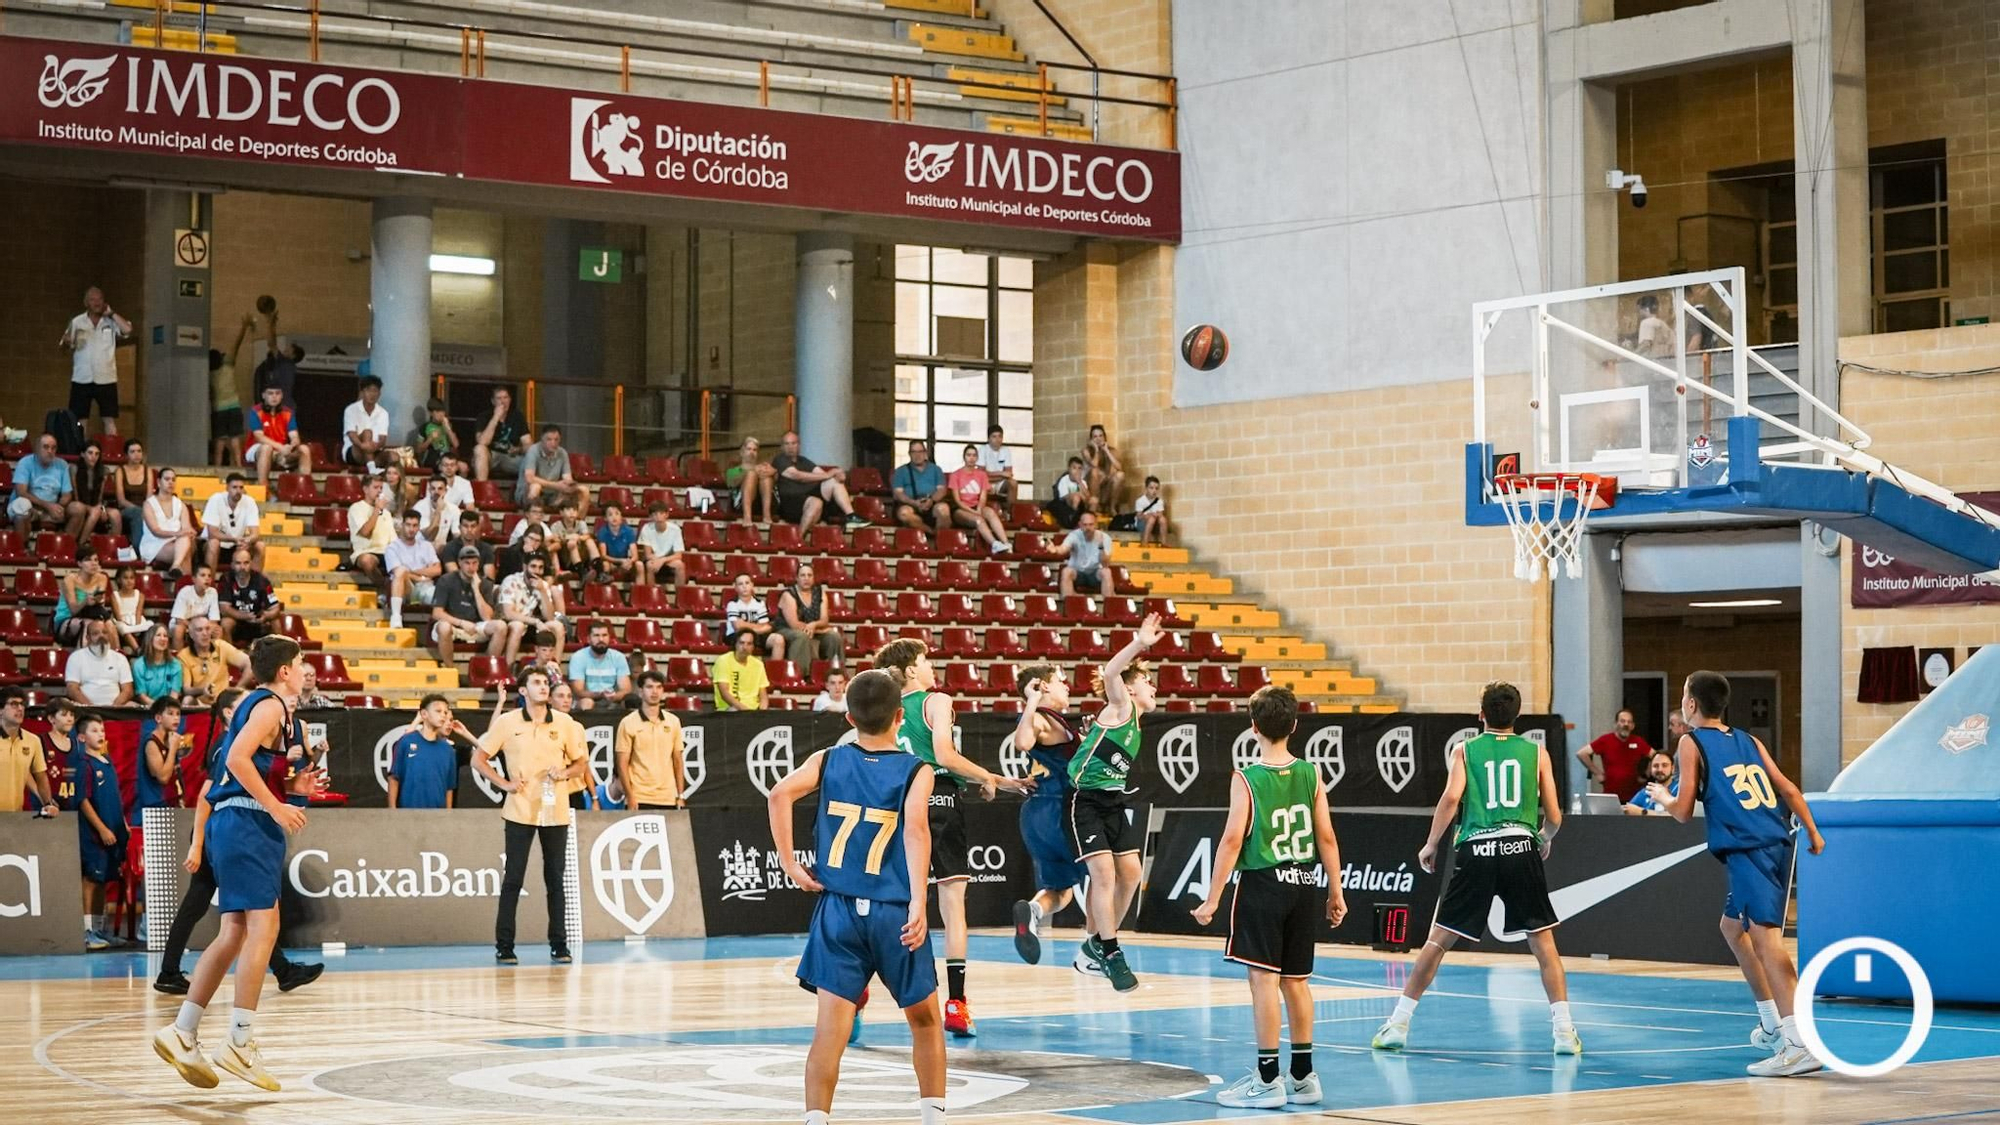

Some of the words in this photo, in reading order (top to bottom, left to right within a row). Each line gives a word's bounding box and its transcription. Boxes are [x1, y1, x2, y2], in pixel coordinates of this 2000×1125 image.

[126, 56, 402, 135] IMDECO
[38, 120, 114, 143] Instituto
[118, 127, 207, 151] Municipal
[211, 135, 235, 153] de
[239, 137, 319, 161] Deportes
[324, 143, 397, 165] Córdoba
[656, 124, 787, 161] Diputación
[655, 156, 687, 181] de
[692, 158, 788, 190] Córdoba
[964, 142, 1154, 204] IMDECO
[906, 191, 958, 210] Instituto
[960, 196, 1022, 217] Municipal
[1024, 203, 1041, 217] de
[1043, 204, 1098, 224] Deportes
[1100, 208, 1152, 227] Córdoba
[592, 251, 608, 277] J
[1863, 577, 1910, 591] Instituto
[1912, 574, 1969, 592] Municipal
[594, 729, 609, 740] FEB
[685, 730, 700, 740] FEB
[773, 729, 788, 740] FEB
[1180, 728, 1194, 737] FEB
[1327, 729, 1340, 738] FEB
[1397, 730, 1409, 738] FEB
[1483, 758, 1522, 810] 10
[1723, 763, 1778, 811] 30
[634, 823, 660, 835] FEB
[827, 800, 900, 876] 77
[1270, 803, 1314, 862] 22
[1472, 840, 1497, 857] vdf
[1498, 838, 1533, 855] team
[288, 849, 528, 898] CaixaBan
[767, 871, 783, 889] DE
[977, 873, 1007, 883] Córdoba
[1274, 867, 1300, 885] vdf
[1386, 908, 1409, 943] 10
